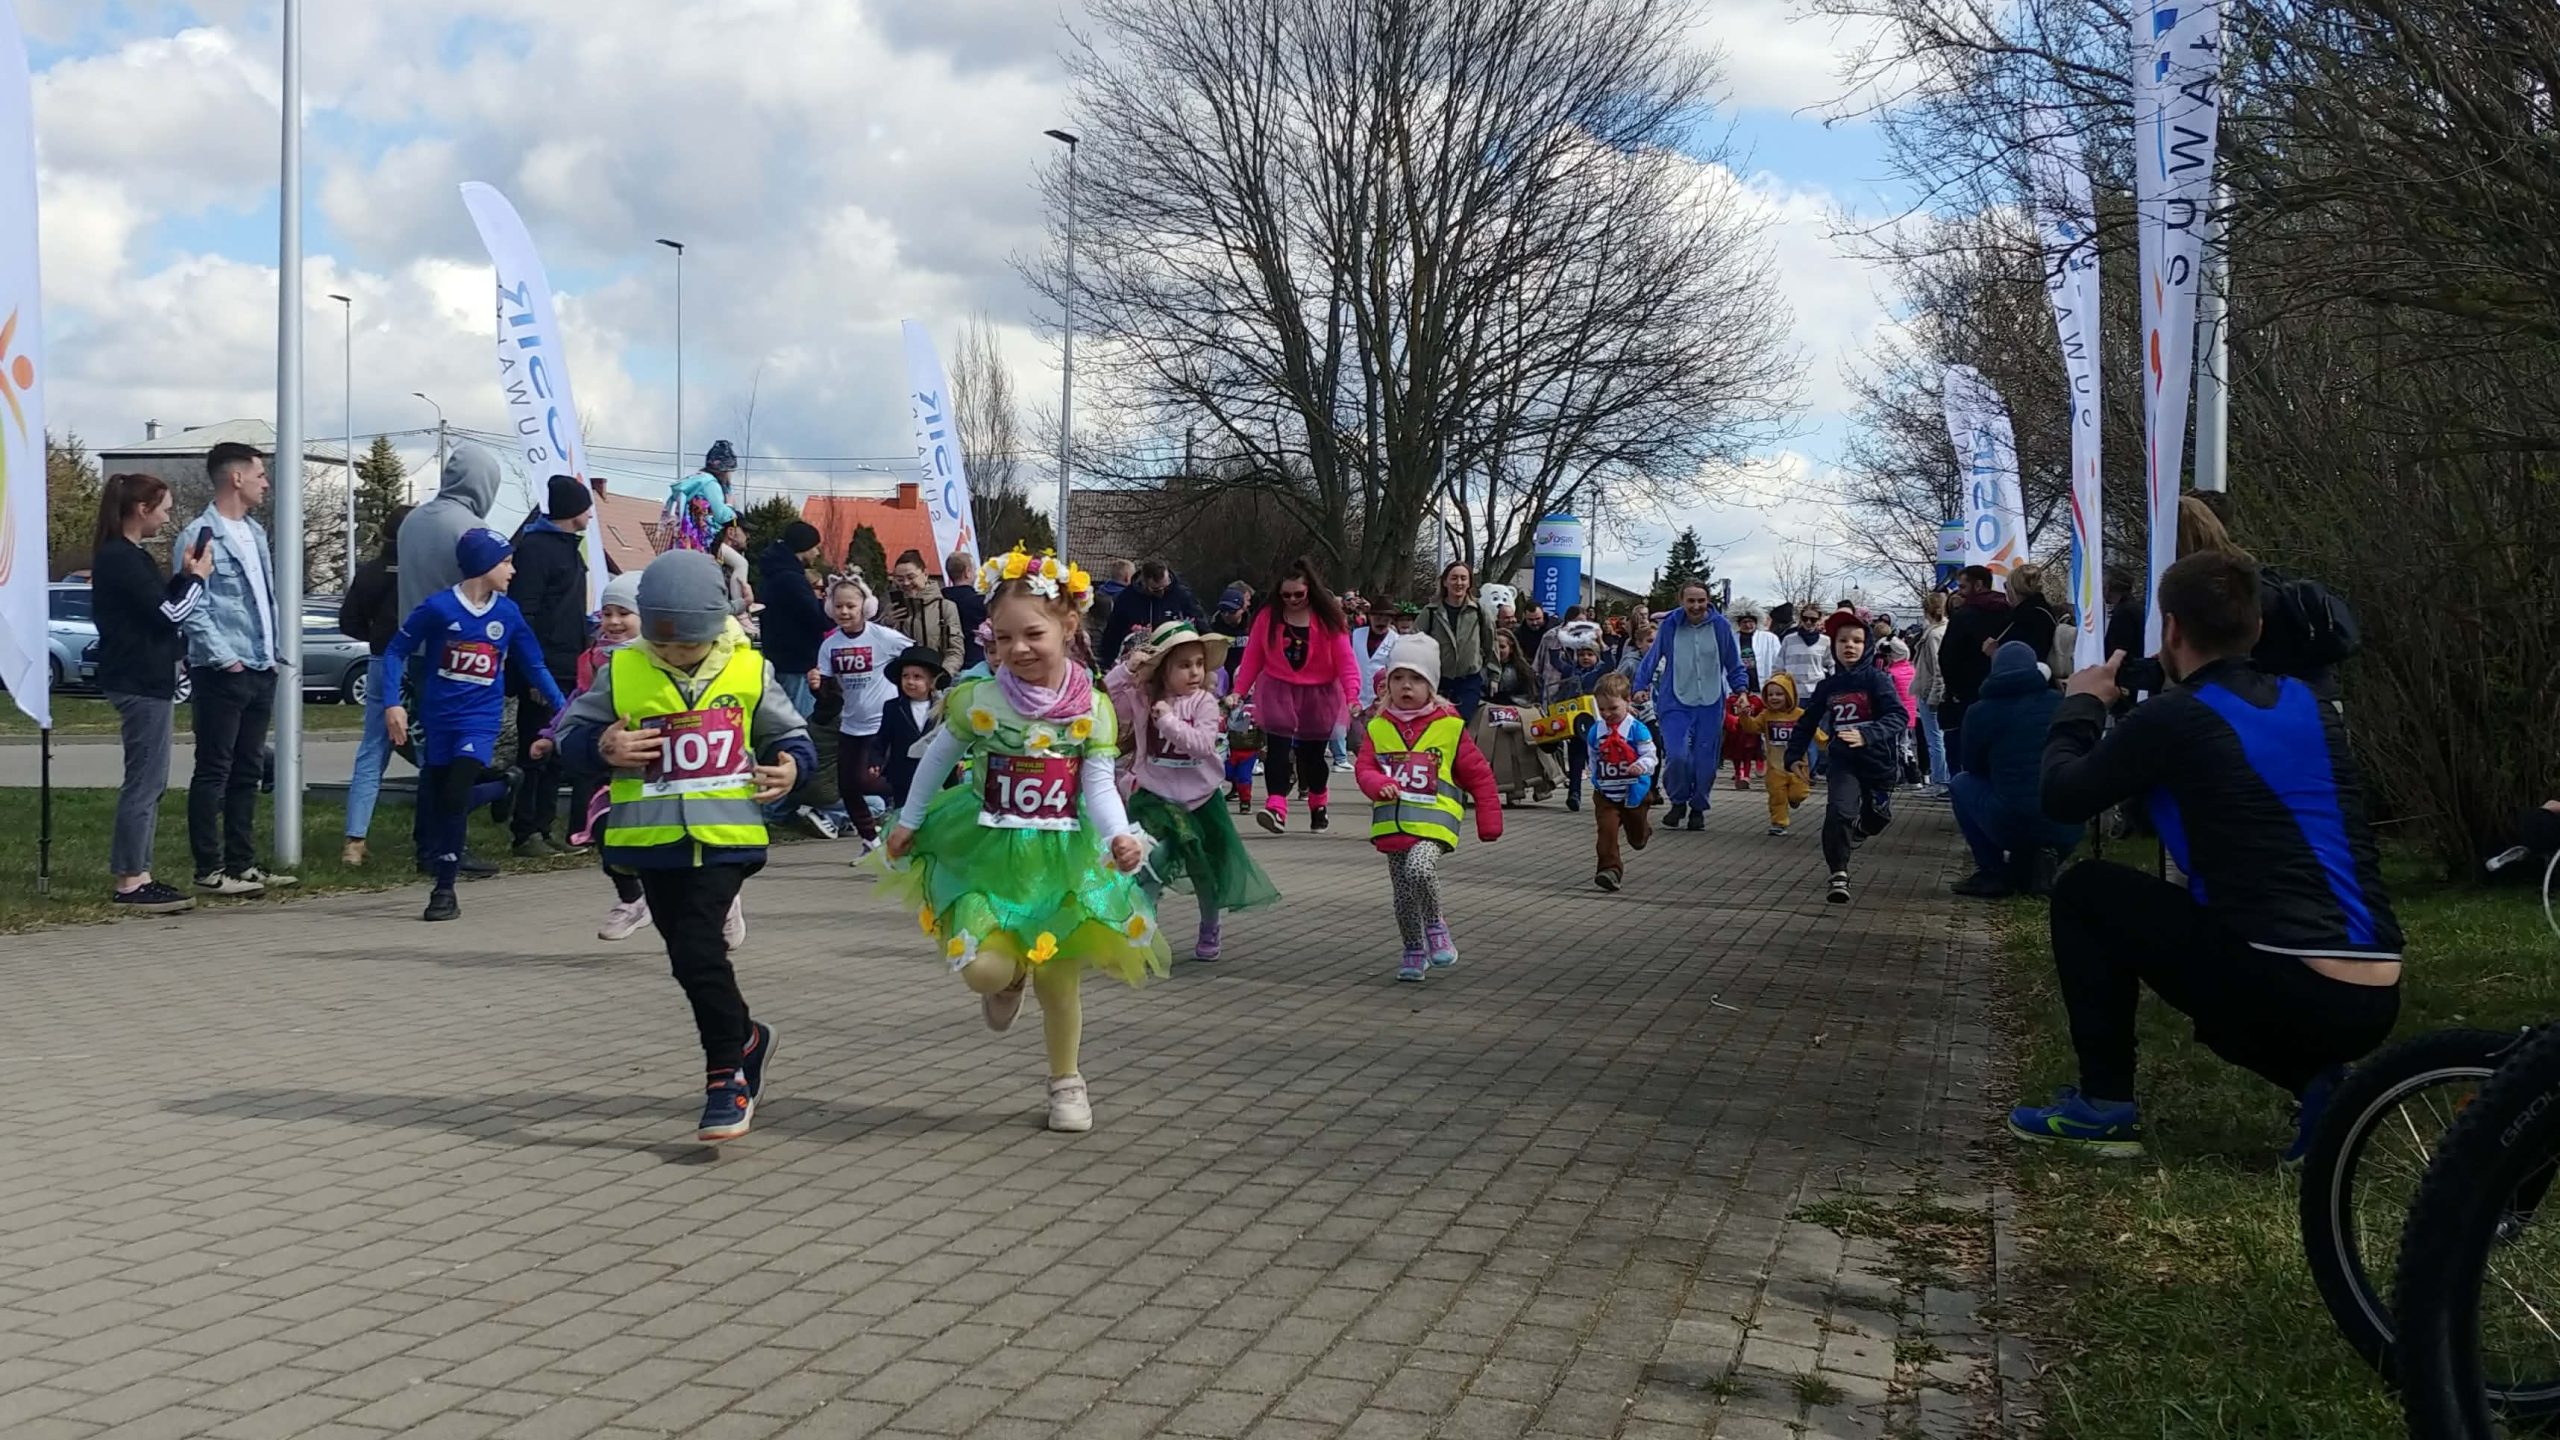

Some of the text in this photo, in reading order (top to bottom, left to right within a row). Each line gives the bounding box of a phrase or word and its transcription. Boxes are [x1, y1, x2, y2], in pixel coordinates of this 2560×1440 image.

[450, 650, 491, 674] 179
[836, 654, 866, 671] 178
[1492, 710, 1514, 721] 194
[1833, 703, 1859, 721] 22
[661, 729, 735, 771] 107
[996, 775, 1068, 813] 164
